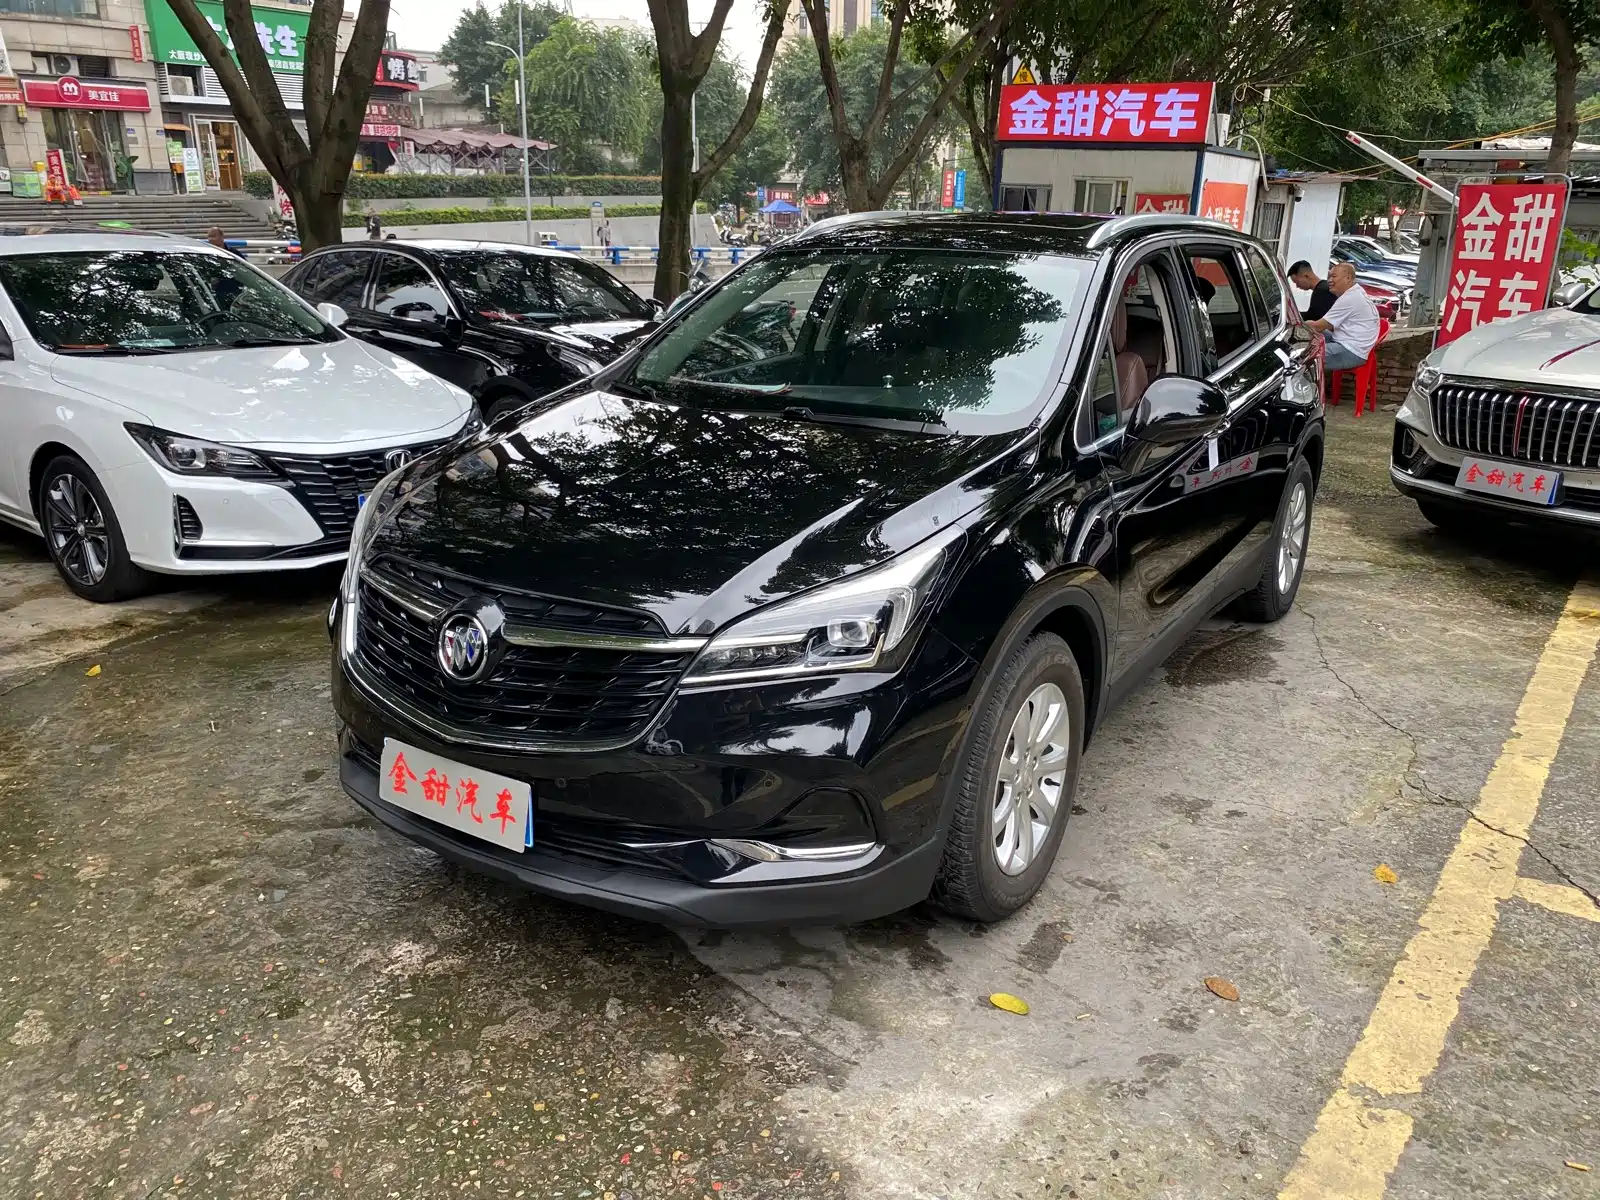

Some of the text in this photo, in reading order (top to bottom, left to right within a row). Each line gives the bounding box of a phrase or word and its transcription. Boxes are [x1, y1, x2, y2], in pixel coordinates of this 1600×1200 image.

[88, 90, 120, 102] 美宜佳
[1009, 88, 1199, 138] 金甜汽车
[1458, 192, 1556, 263] 金甜
[1446, 269, 1538, 333] 汽车
[1464, 463, 1547, 496] 金甜汽车
[388, 752, 516, 835] 金甜汽车
